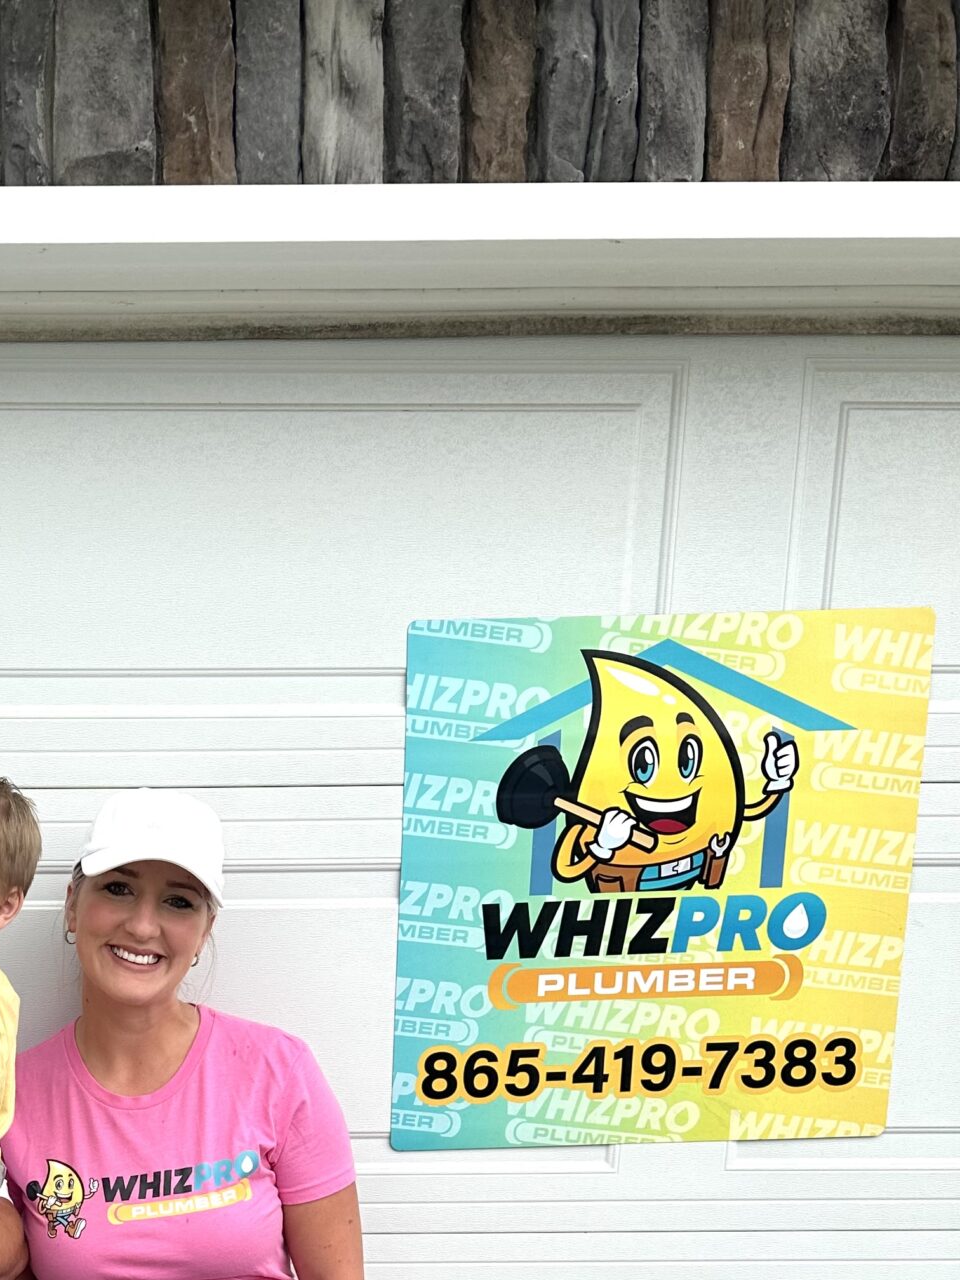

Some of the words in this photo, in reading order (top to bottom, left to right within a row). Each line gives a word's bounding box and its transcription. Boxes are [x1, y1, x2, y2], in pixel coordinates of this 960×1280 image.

[813, 729, 925, 771] WHIZ
[404, 772, 498, 816] IZPR
[482, 891, 827, 961] WHIZPRO
[808, 929, 904, 969] HIZP
[537, 967, 756, 996] PLUMBER
[804, 970, 901, 992] LUMBE
[525, 1000, 720, 1041] WHIZPRO
[422, 1037, 856, 1100] 865-419-7383
[506, 1088, 701, 1133] WHIZPRO
[102, 1150, 259, 1202] WHIZPRO
[131, 1189, 238, 1218] PLUMBER
